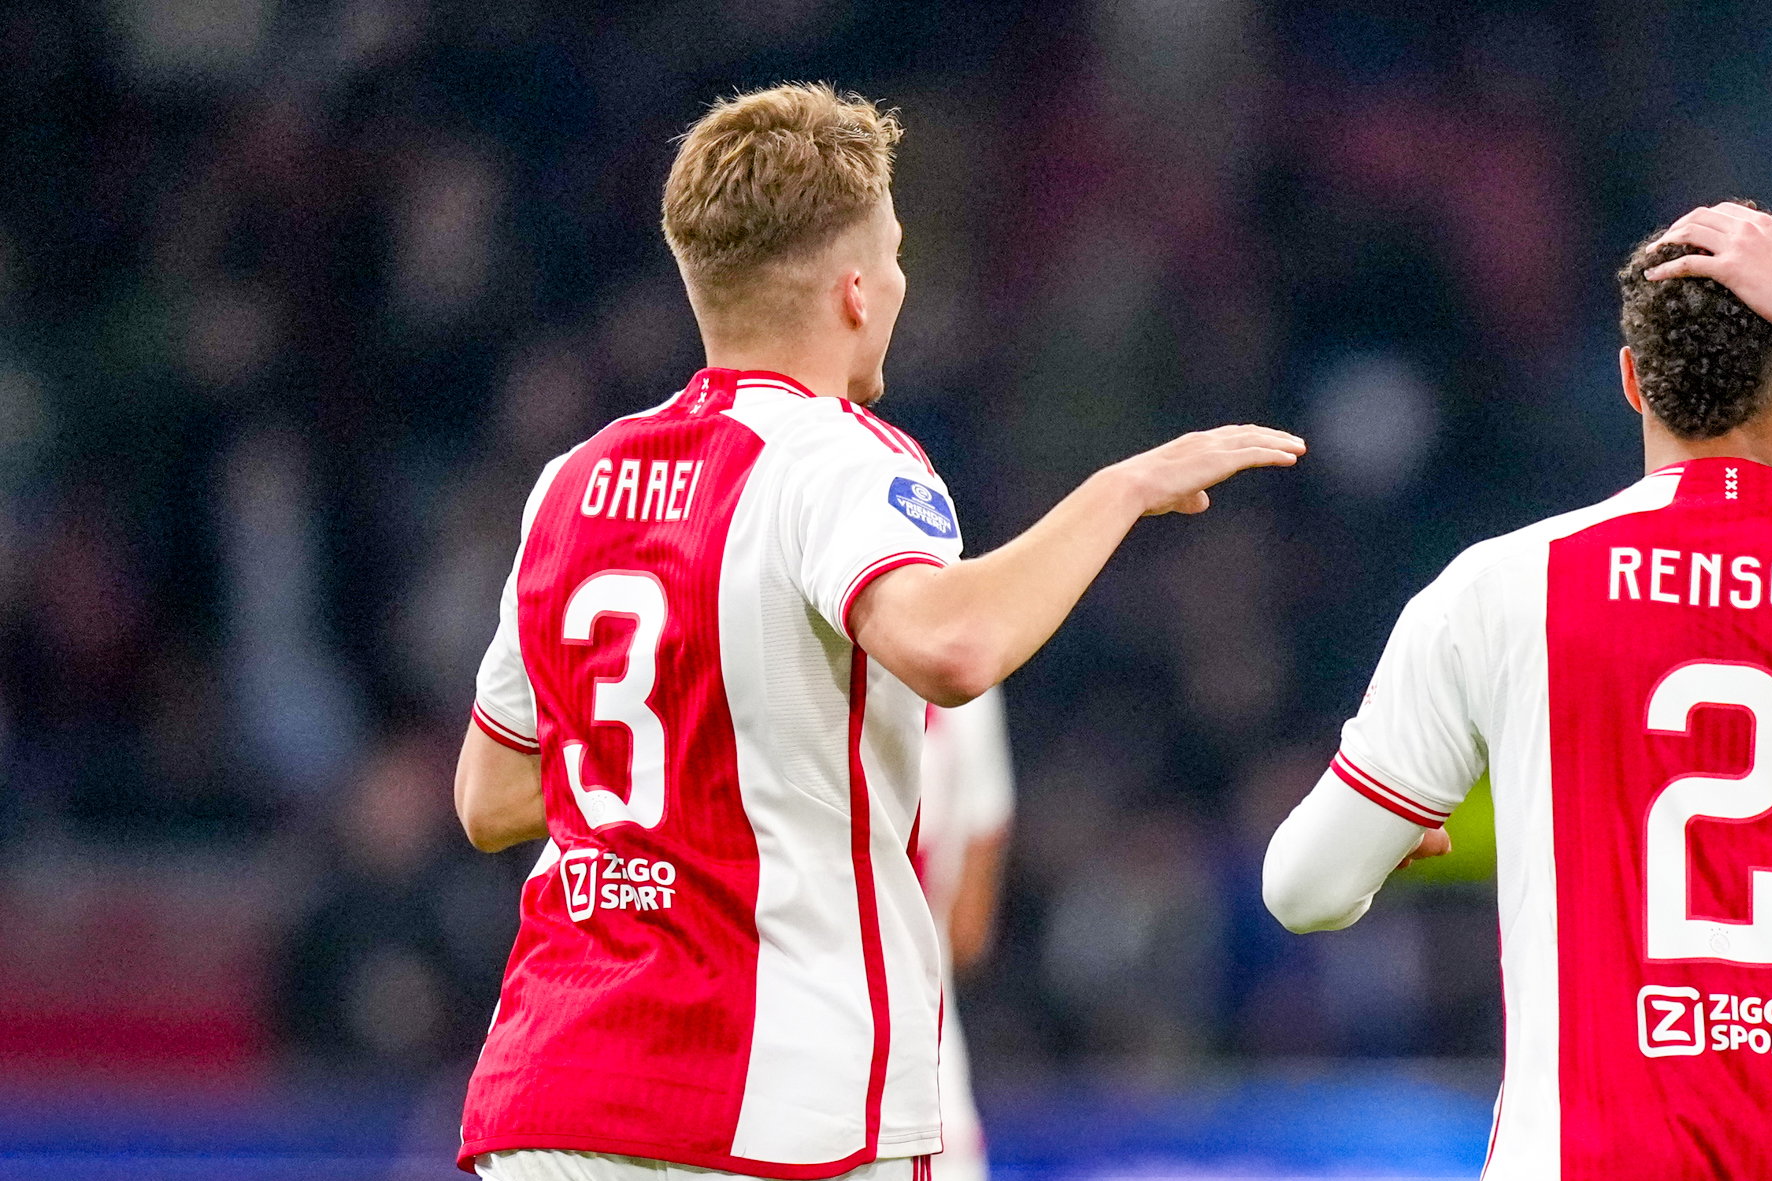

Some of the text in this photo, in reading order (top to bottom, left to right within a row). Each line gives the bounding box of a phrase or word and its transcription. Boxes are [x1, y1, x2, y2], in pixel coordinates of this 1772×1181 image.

[580, 457, 705, 522] GAAEI
[562, 568, 670, 831] 3
[601, 852, 677, 886] ZGO
